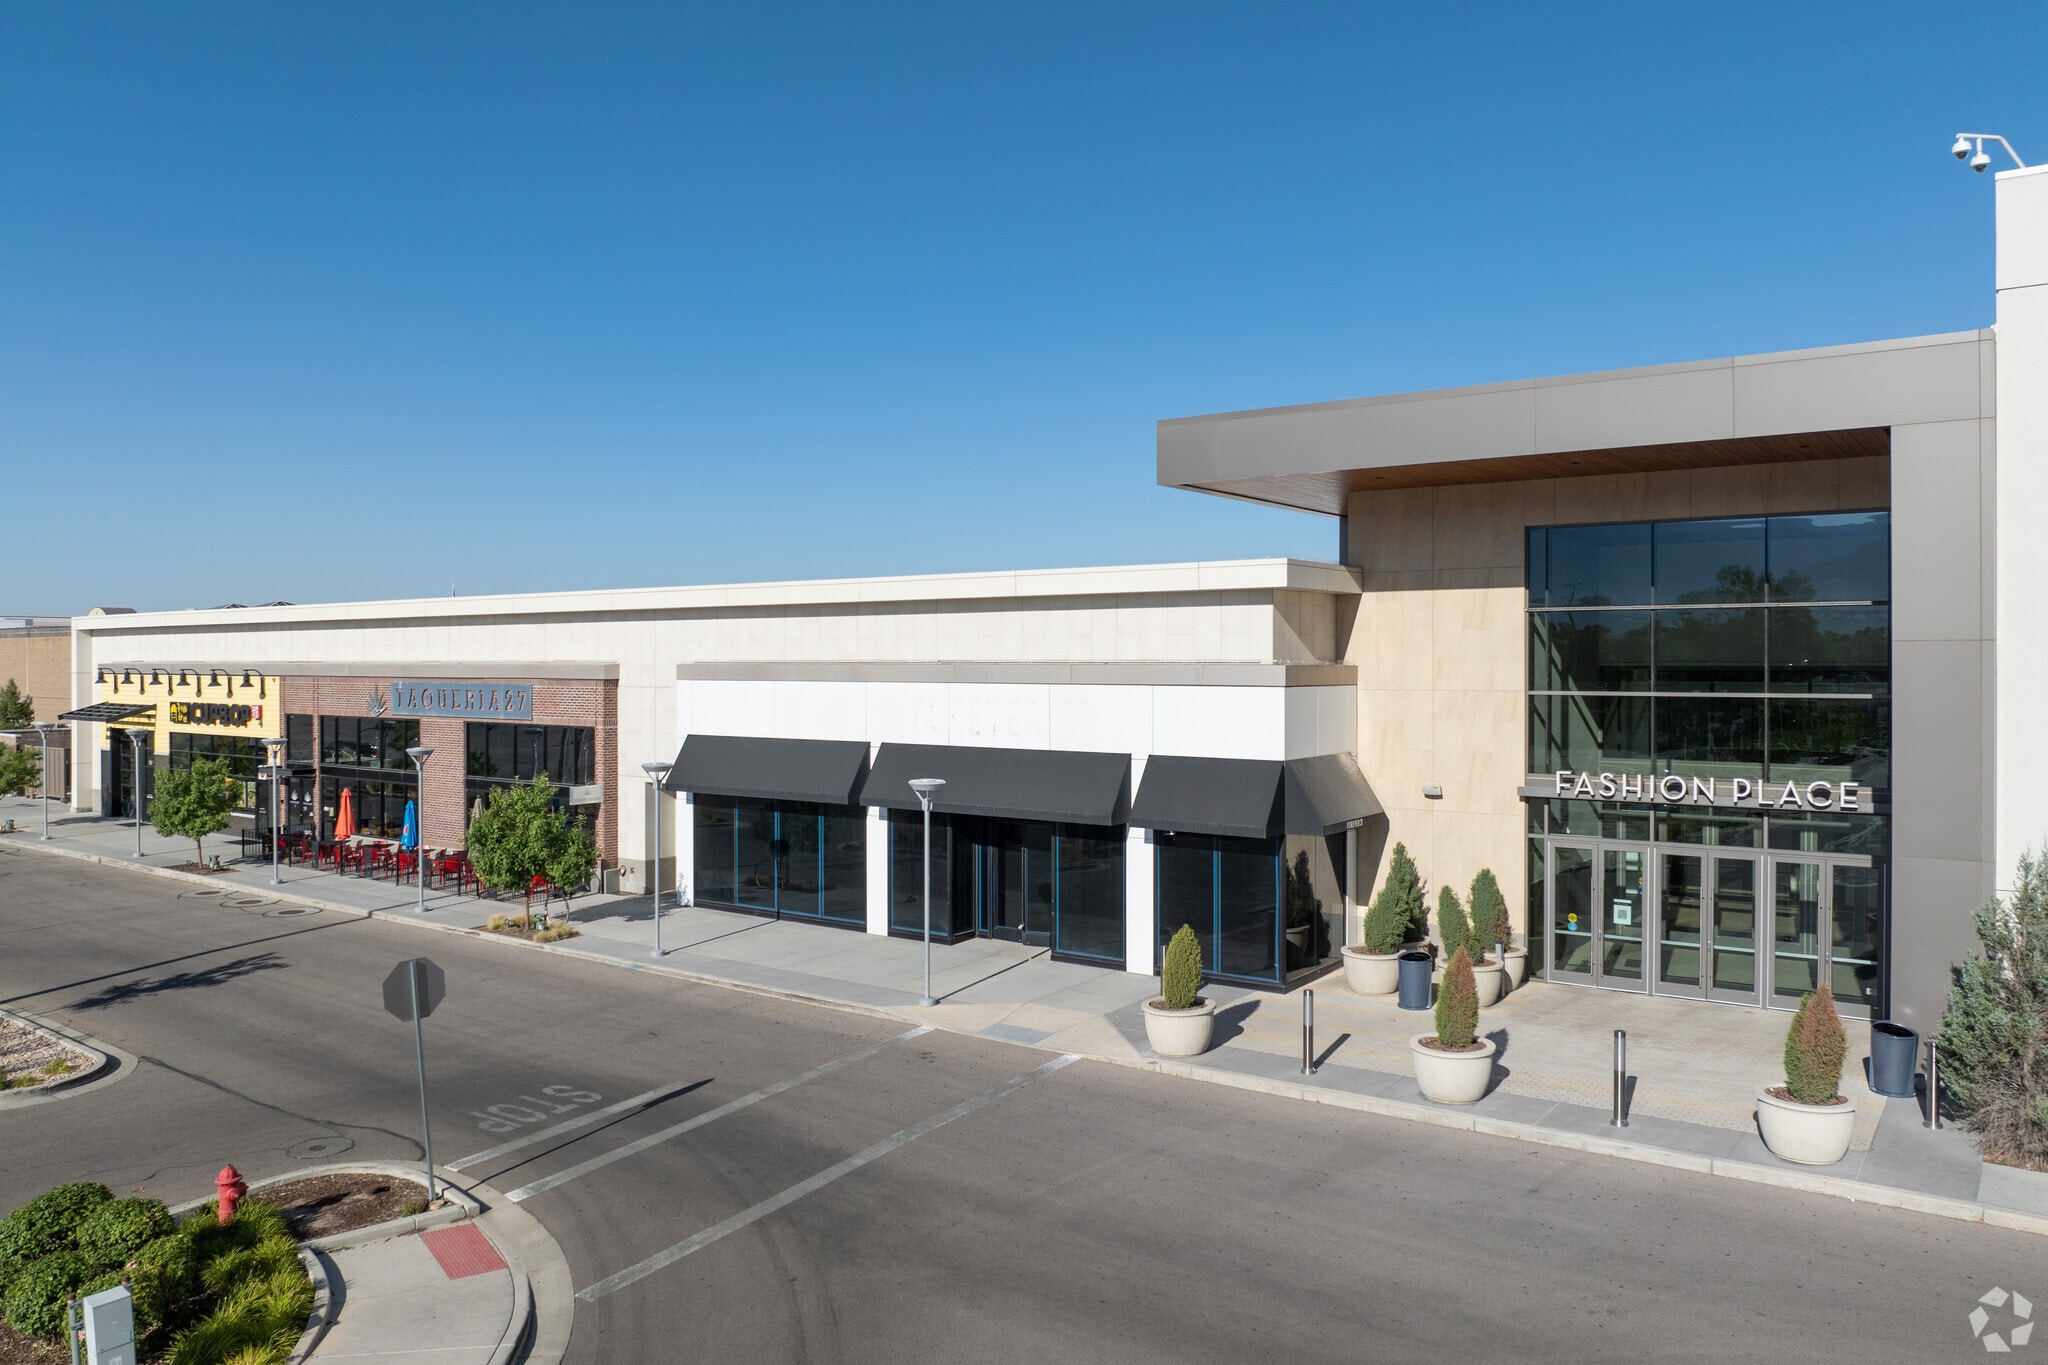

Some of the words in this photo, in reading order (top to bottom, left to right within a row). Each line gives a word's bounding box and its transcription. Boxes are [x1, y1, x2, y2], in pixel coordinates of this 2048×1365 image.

[189, 702, 251, 727] CUPBOP
[1555, 770, 1715, 803] FASHION
[1732, 777, 1859, 809] PLACE
[470, 1084, 603, 1133] STOP
